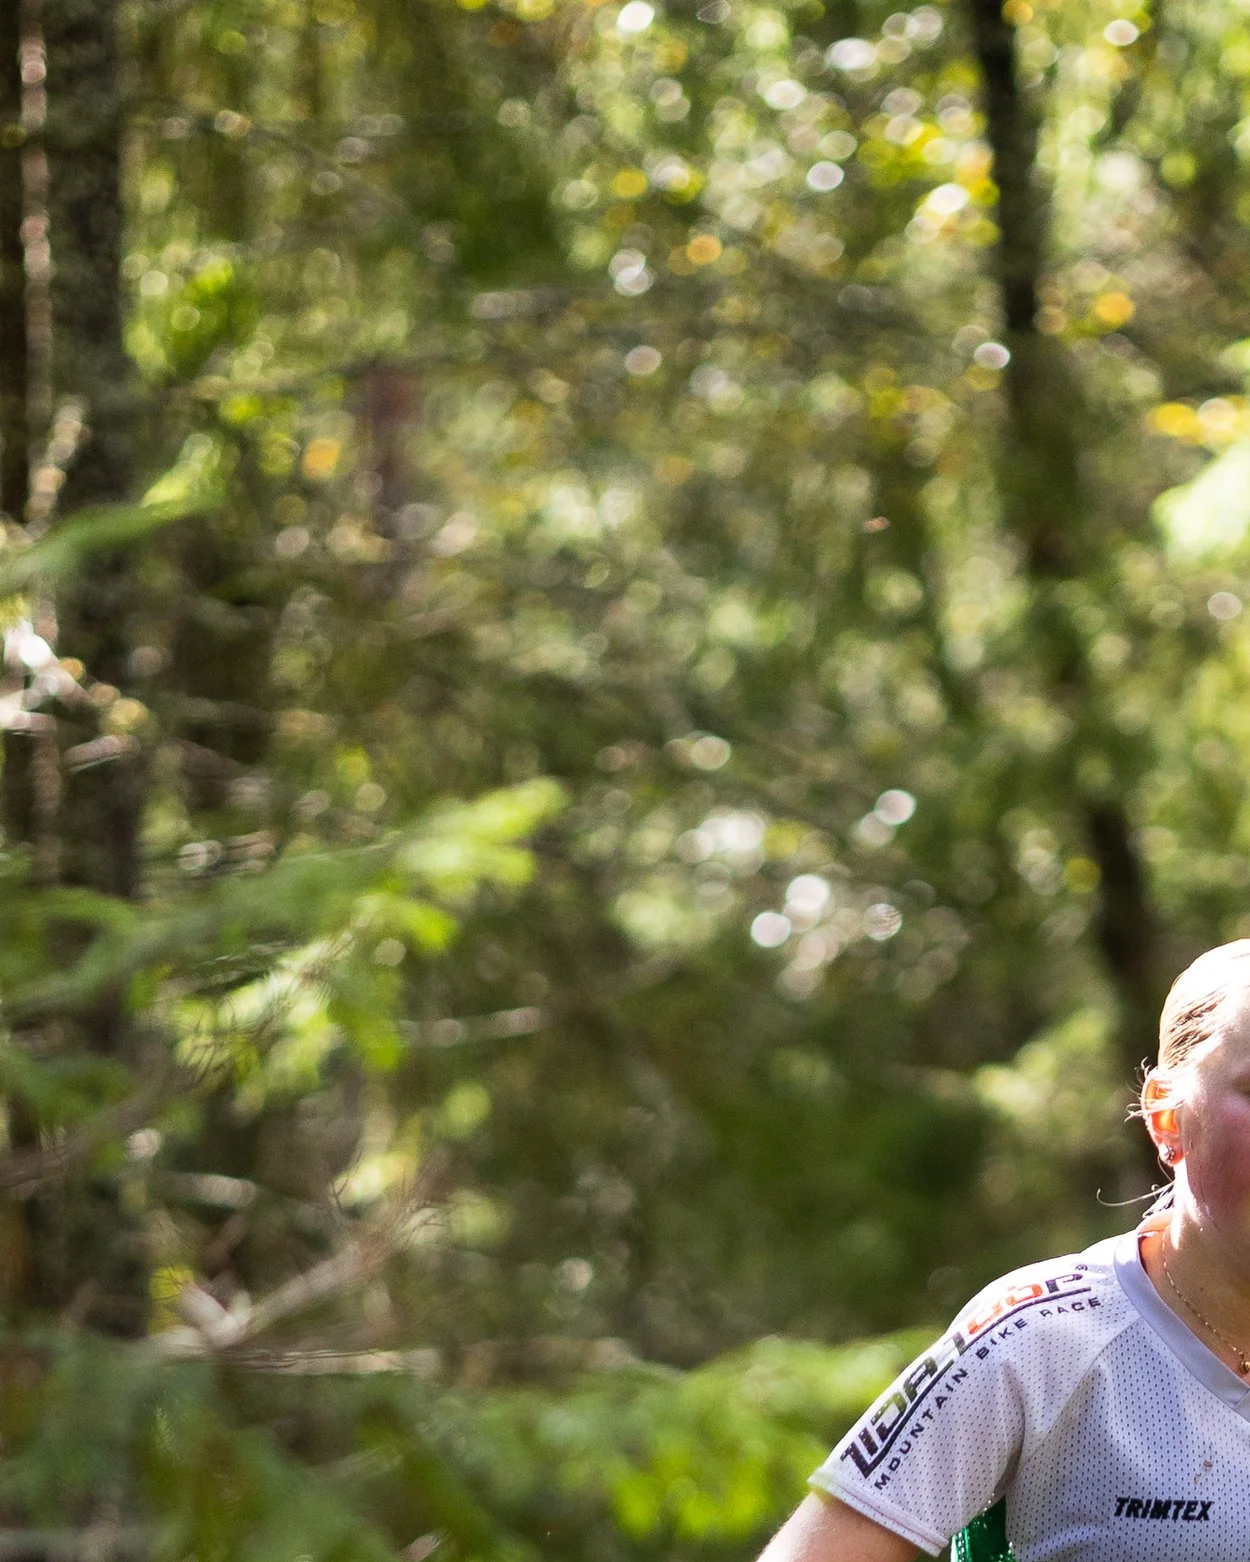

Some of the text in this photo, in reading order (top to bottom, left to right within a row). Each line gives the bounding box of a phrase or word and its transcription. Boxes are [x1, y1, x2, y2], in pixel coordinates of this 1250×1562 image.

[874, 1296, 1101, 1490] MOUNTAIN BIKE RACE
[1114, 1496, 1215, 1521] TRIMTEX
